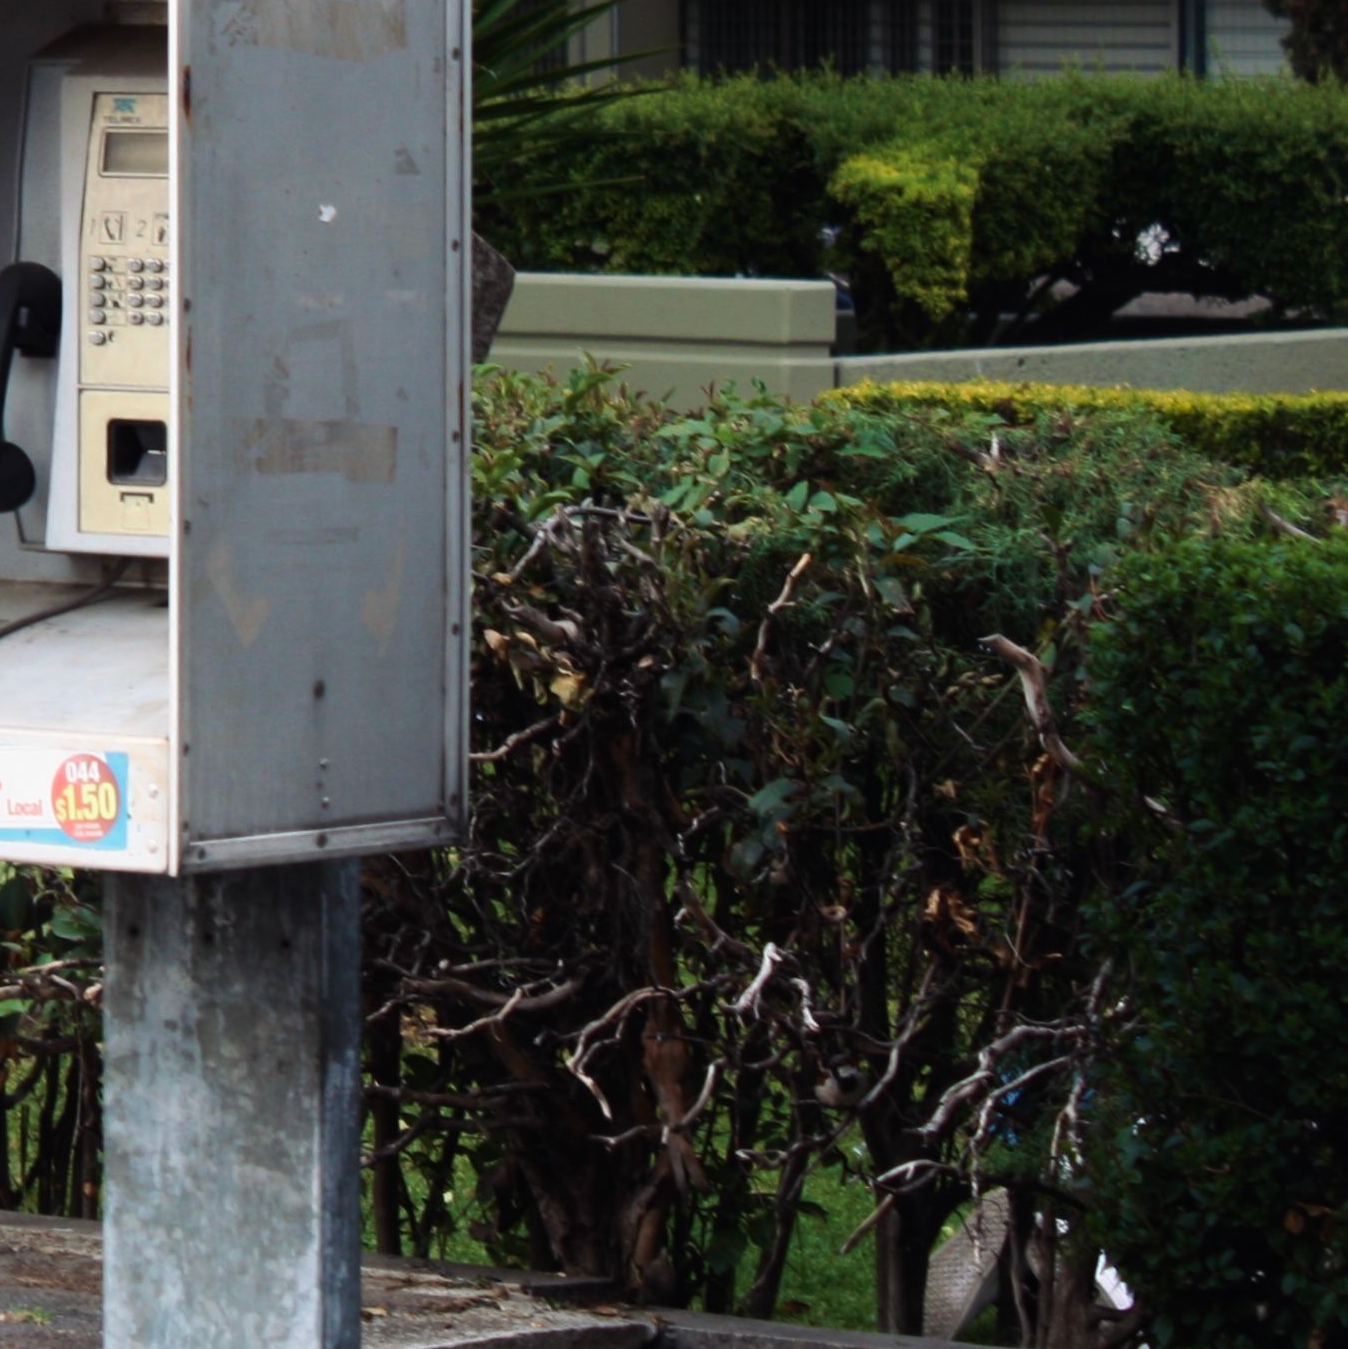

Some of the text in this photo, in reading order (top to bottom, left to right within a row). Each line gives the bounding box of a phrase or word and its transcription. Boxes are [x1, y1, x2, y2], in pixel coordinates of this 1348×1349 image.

[65, 761, 100, 783] 044
[8, 799, 42, 815] Local
[55, 782, 117, 822] $1.50
